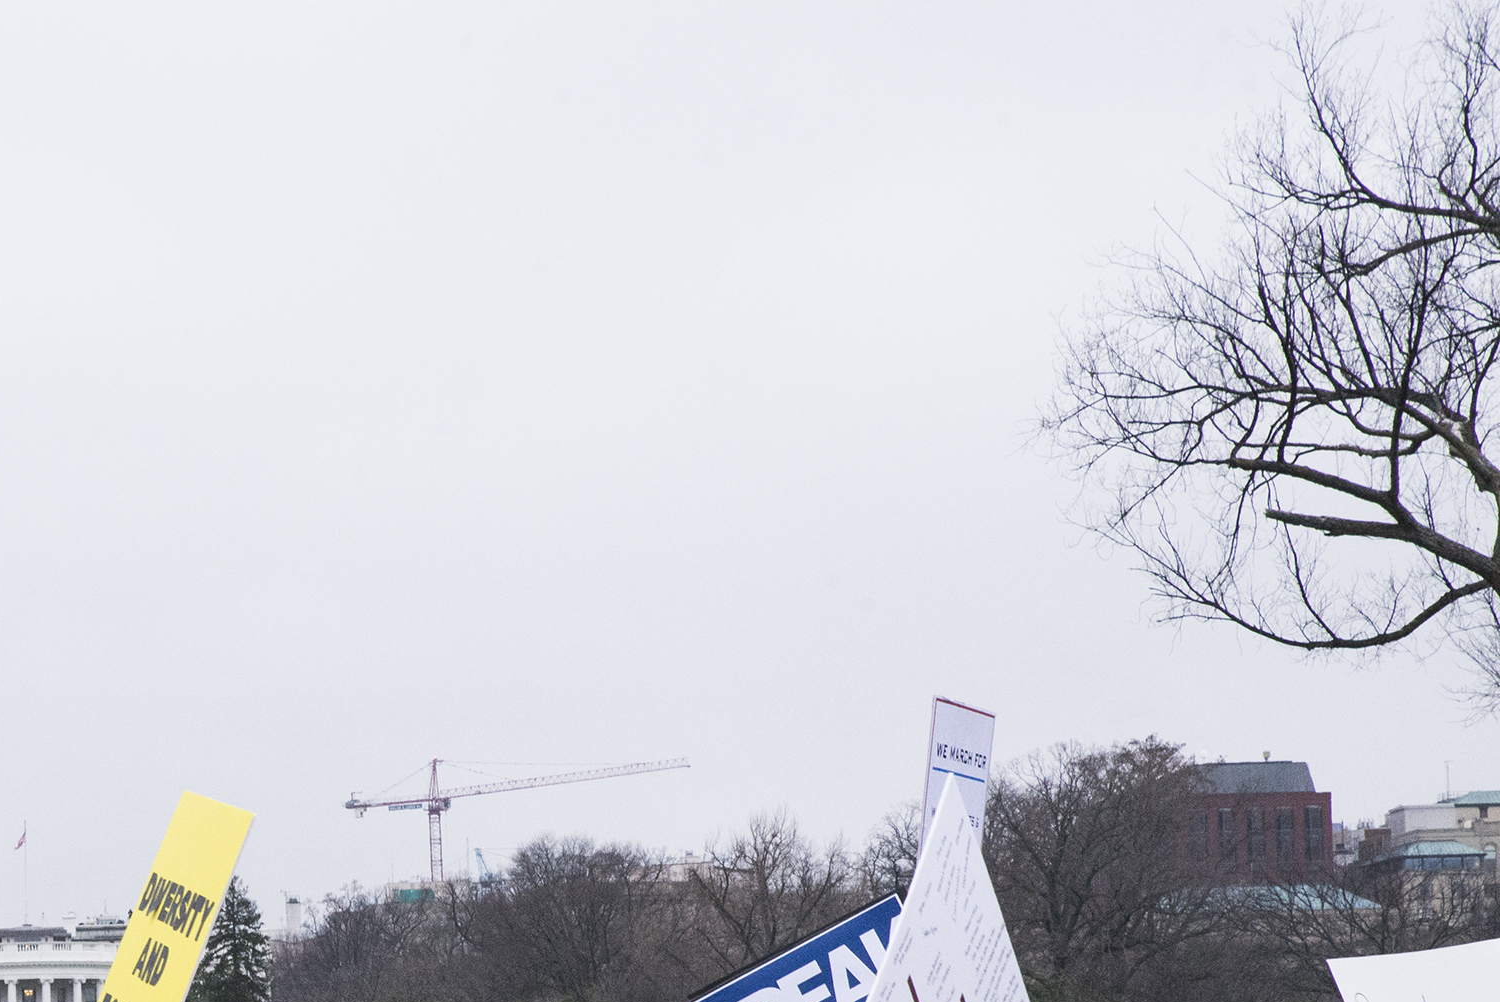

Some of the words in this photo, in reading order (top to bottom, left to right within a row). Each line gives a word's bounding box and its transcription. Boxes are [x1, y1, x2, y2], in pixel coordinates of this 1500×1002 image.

[937, 742, 948, 759] WE
[950, 746, 972, 766] MARCH
[975, 754, 987, 770] FOR
[138, 872, 215, 941] DIVERSITY
[132, 937, 169, 987] AND
